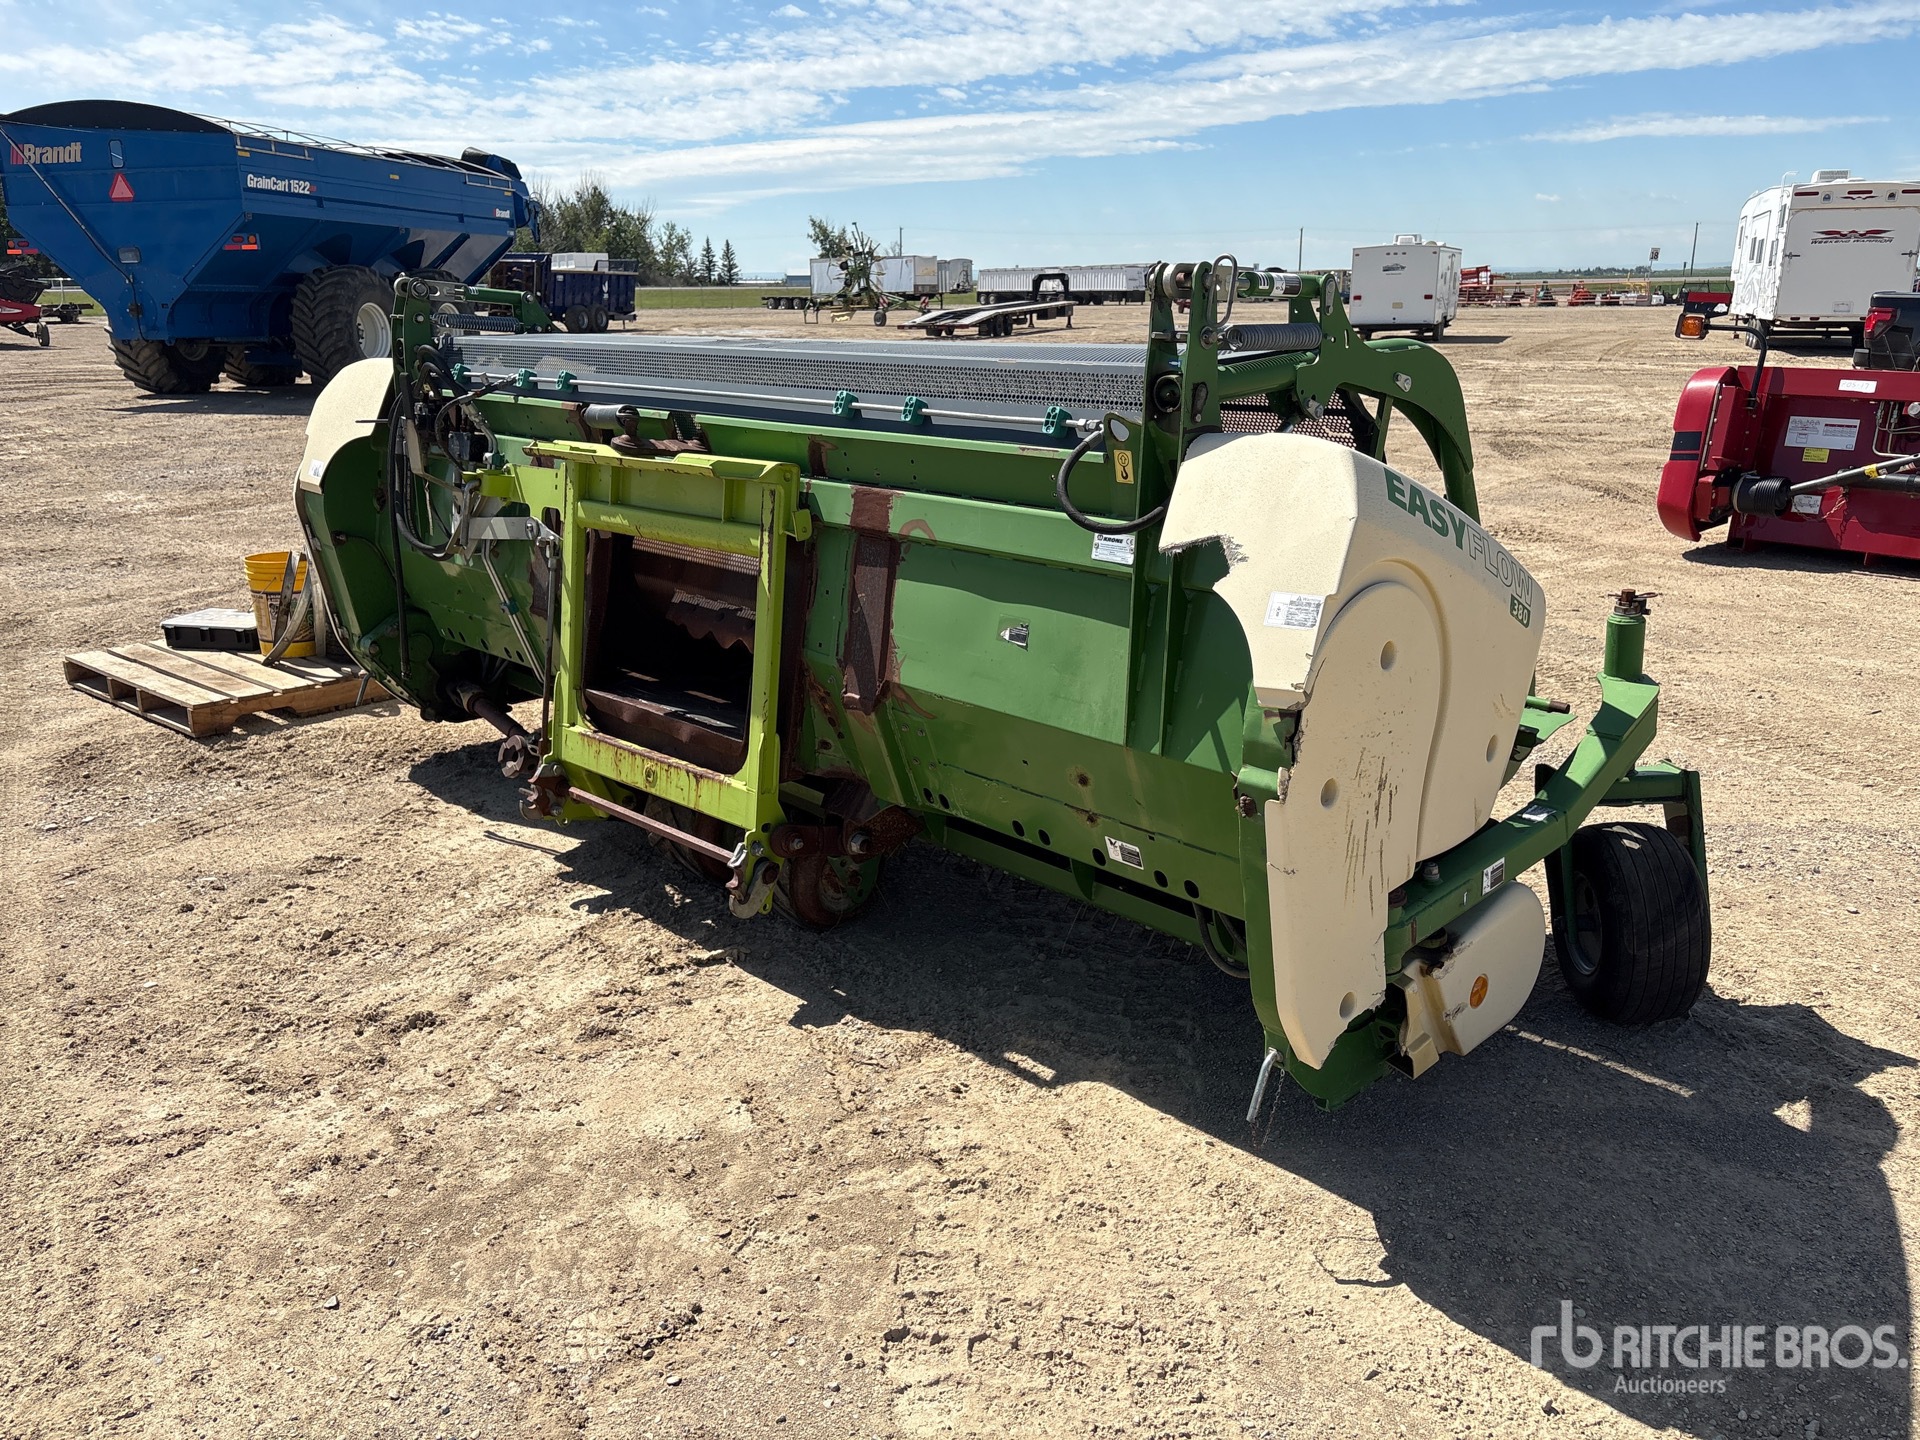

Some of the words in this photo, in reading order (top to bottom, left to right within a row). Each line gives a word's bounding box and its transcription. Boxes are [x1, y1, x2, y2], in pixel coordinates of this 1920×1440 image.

[23, 142, 82, 165] Brandt
[246, 173, 289, 192] GrainCart
[289, 179, 311, 195] 1522
[1650, 251, 1659, 260] 18
[1103, 536, 1124, 544] KRONE
[1511, 598, 1528, 625] 380
